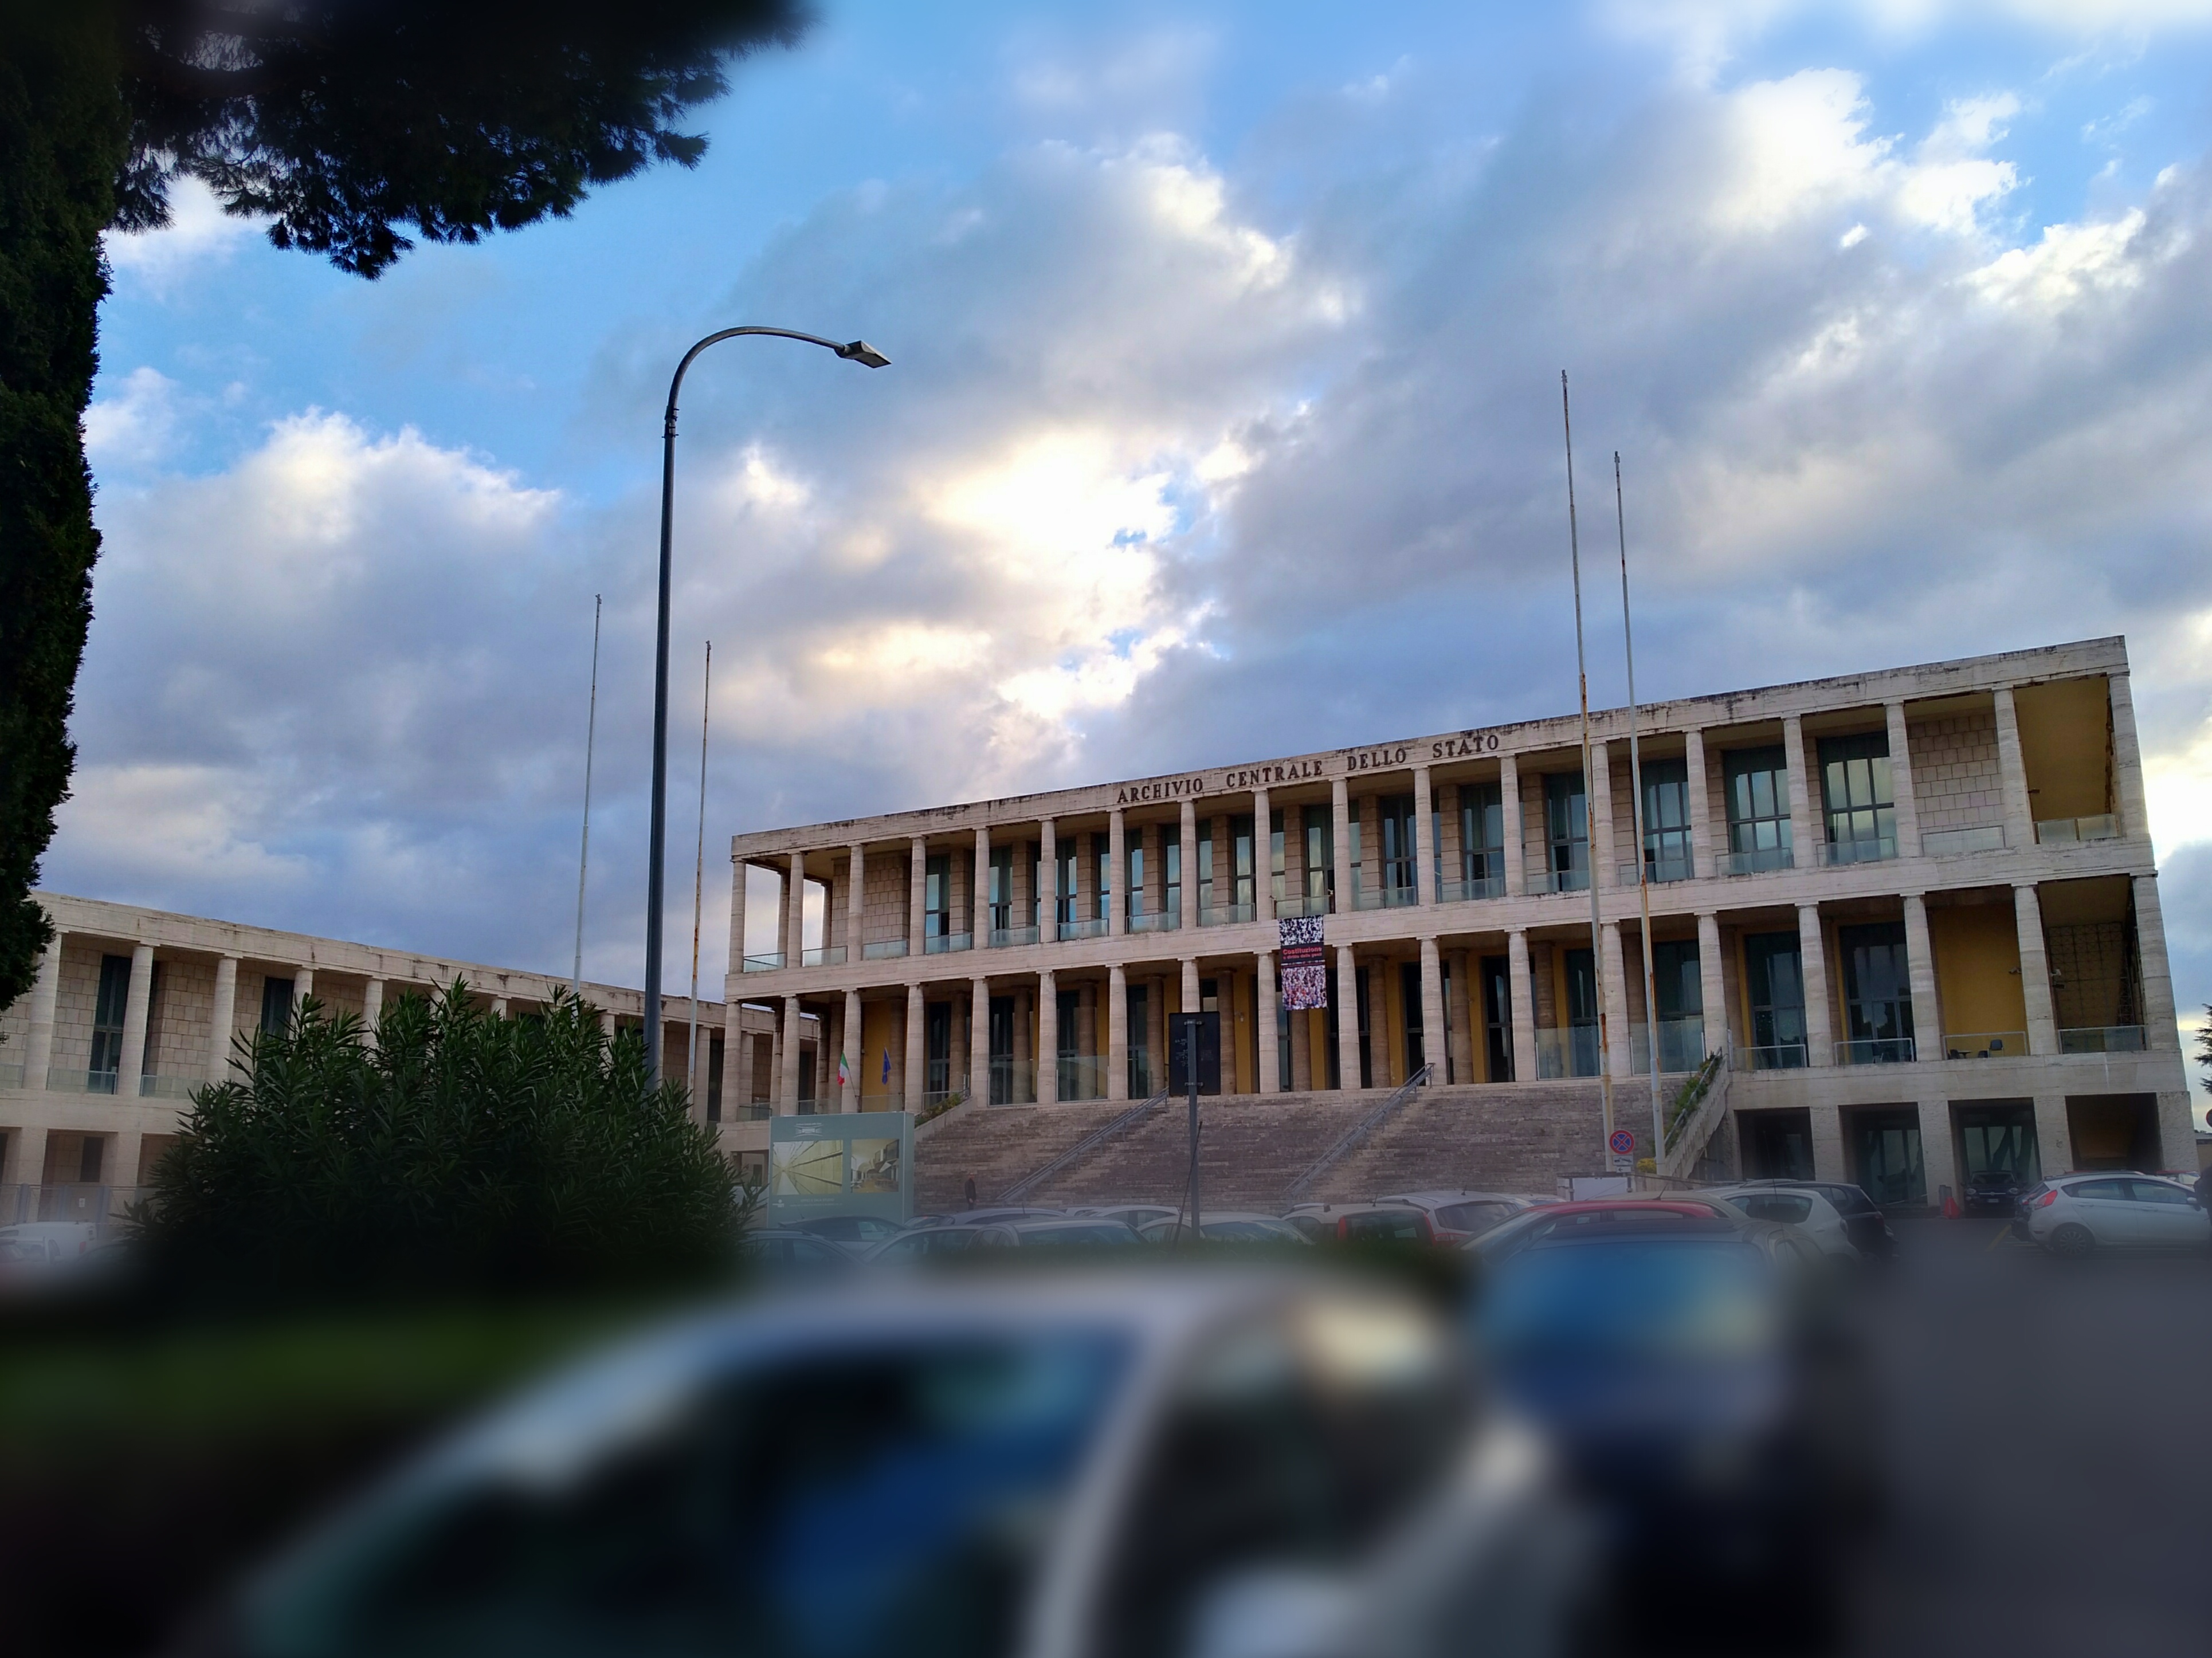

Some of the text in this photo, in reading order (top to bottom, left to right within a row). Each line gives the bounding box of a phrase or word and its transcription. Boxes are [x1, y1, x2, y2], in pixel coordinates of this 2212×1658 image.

[1117, 734, 1499, 803] ARCHIVIO CENTRALE DELLO STATO
[1283, 947, 1322, 955] Costituzione
